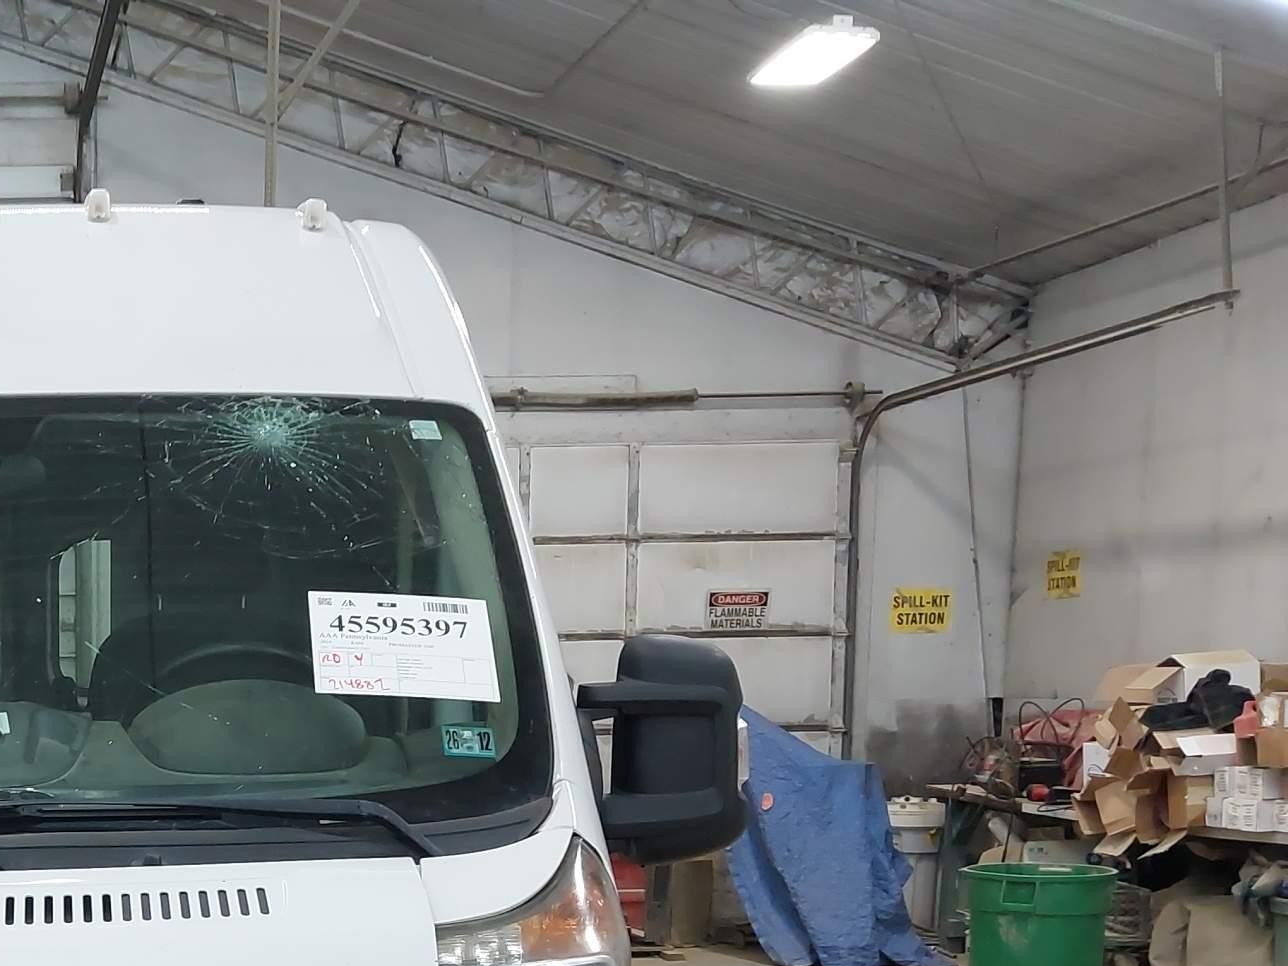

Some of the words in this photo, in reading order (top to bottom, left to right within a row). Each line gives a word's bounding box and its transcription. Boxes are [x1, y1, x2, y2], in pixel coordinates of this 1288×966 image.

[718, 595, 760, 604] DANGER
[893, 594, 951, 608] SPILL-KIT
[709, 607, 767, 618] FLAMMABLE
[896, 612, 945, 626] STATION
[329, 614, 468, 639] 45595397
[711, 618, 763, 629] MATERIALS
[446, 730, 460, 750] 26
[477, 731, 492, 751] 12
